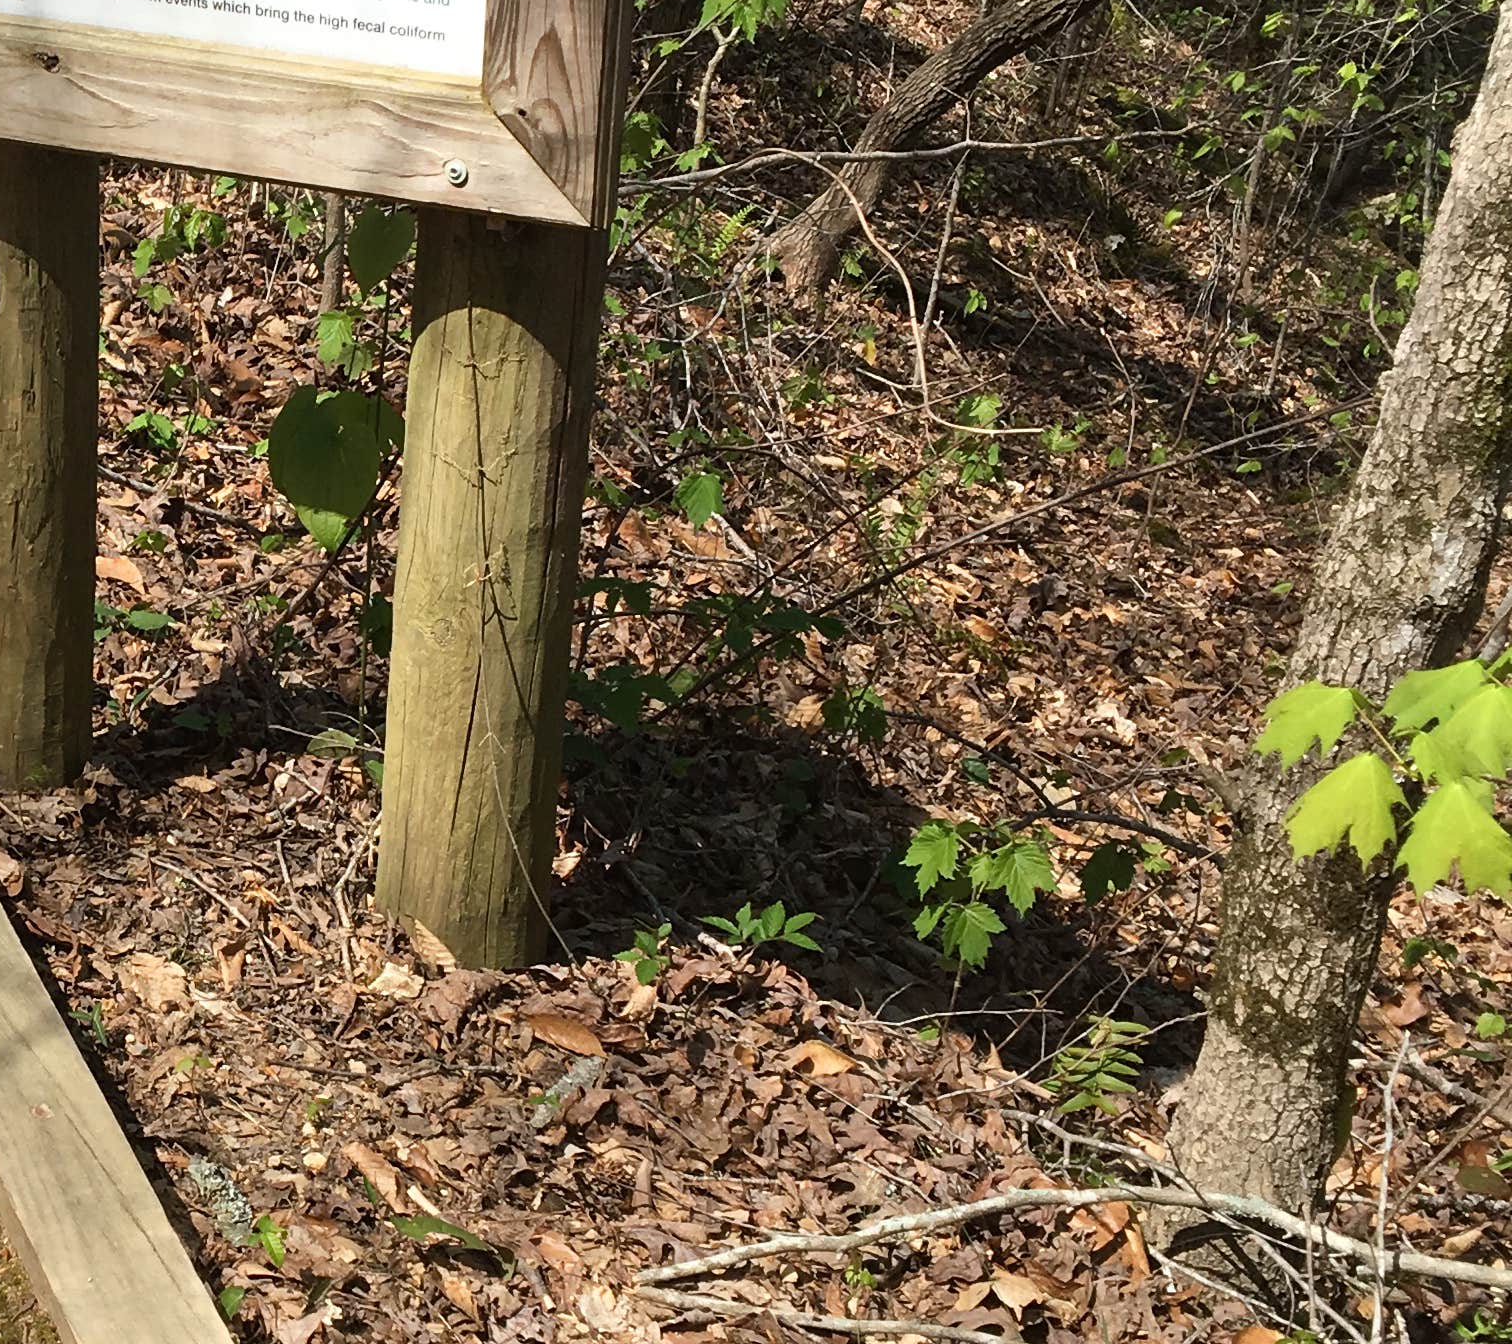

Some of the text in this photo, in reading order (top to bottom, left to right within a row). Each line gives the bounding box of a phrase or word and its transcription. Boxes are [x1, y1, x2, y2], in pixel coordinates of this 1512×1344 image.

[211, 0, 251, 15] which
[255, 3, 289, 23] bring
[293, 9, 315, 24] the
[319, 12, 348, 30] high
[352, 17, 385, 33] fecal
[388, 24, 445, 41] coliform
